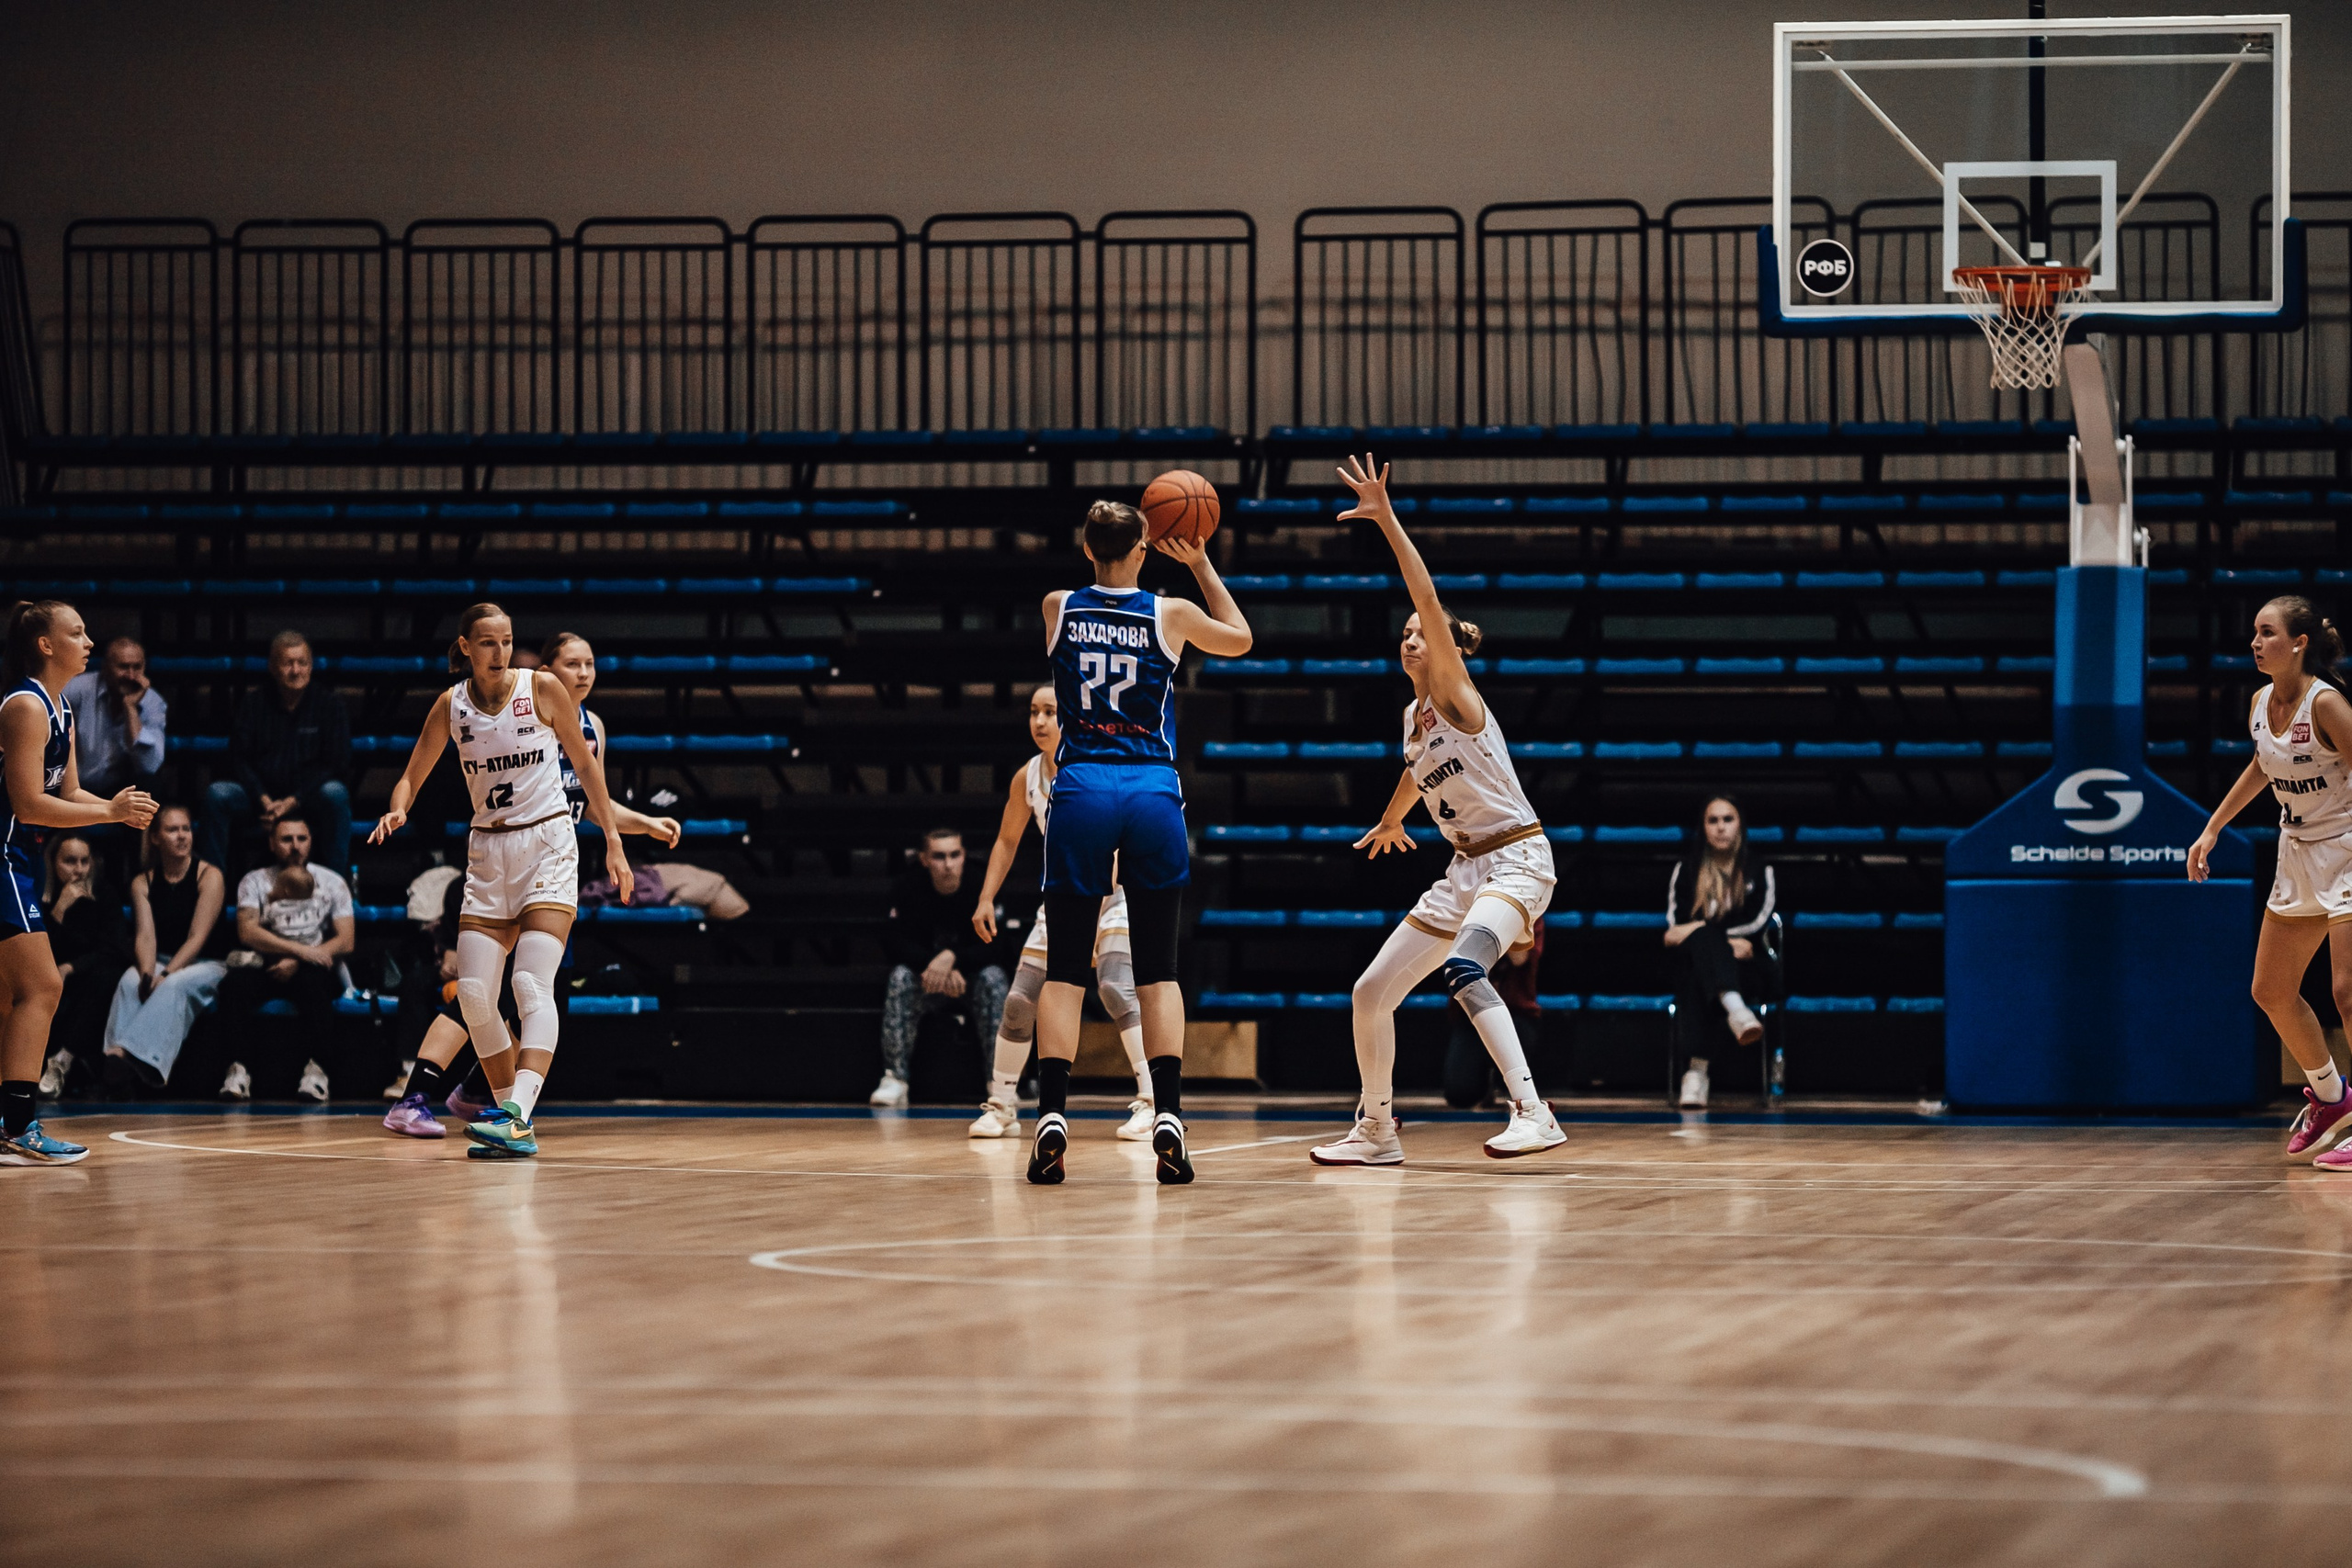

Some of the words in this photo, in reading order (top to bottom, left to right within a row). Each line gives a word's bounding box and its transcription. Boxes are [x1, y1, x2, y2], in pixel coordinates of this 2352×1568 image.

[1804, 259, 1847, 276] РФБ
[1068, 620, 1150, 649] ЗАХАРОВА
[1079, 651, 1138, 712] 77
[514, 705, 531, 715] BET
[2292, 733, 2309, 741] BET
[2293, 725, 2309, 733] FON
[570, 801, 584, 824] 13
[1439, 798, 1456, 819] 6
[2109, 844, 2187, 866] Sports
